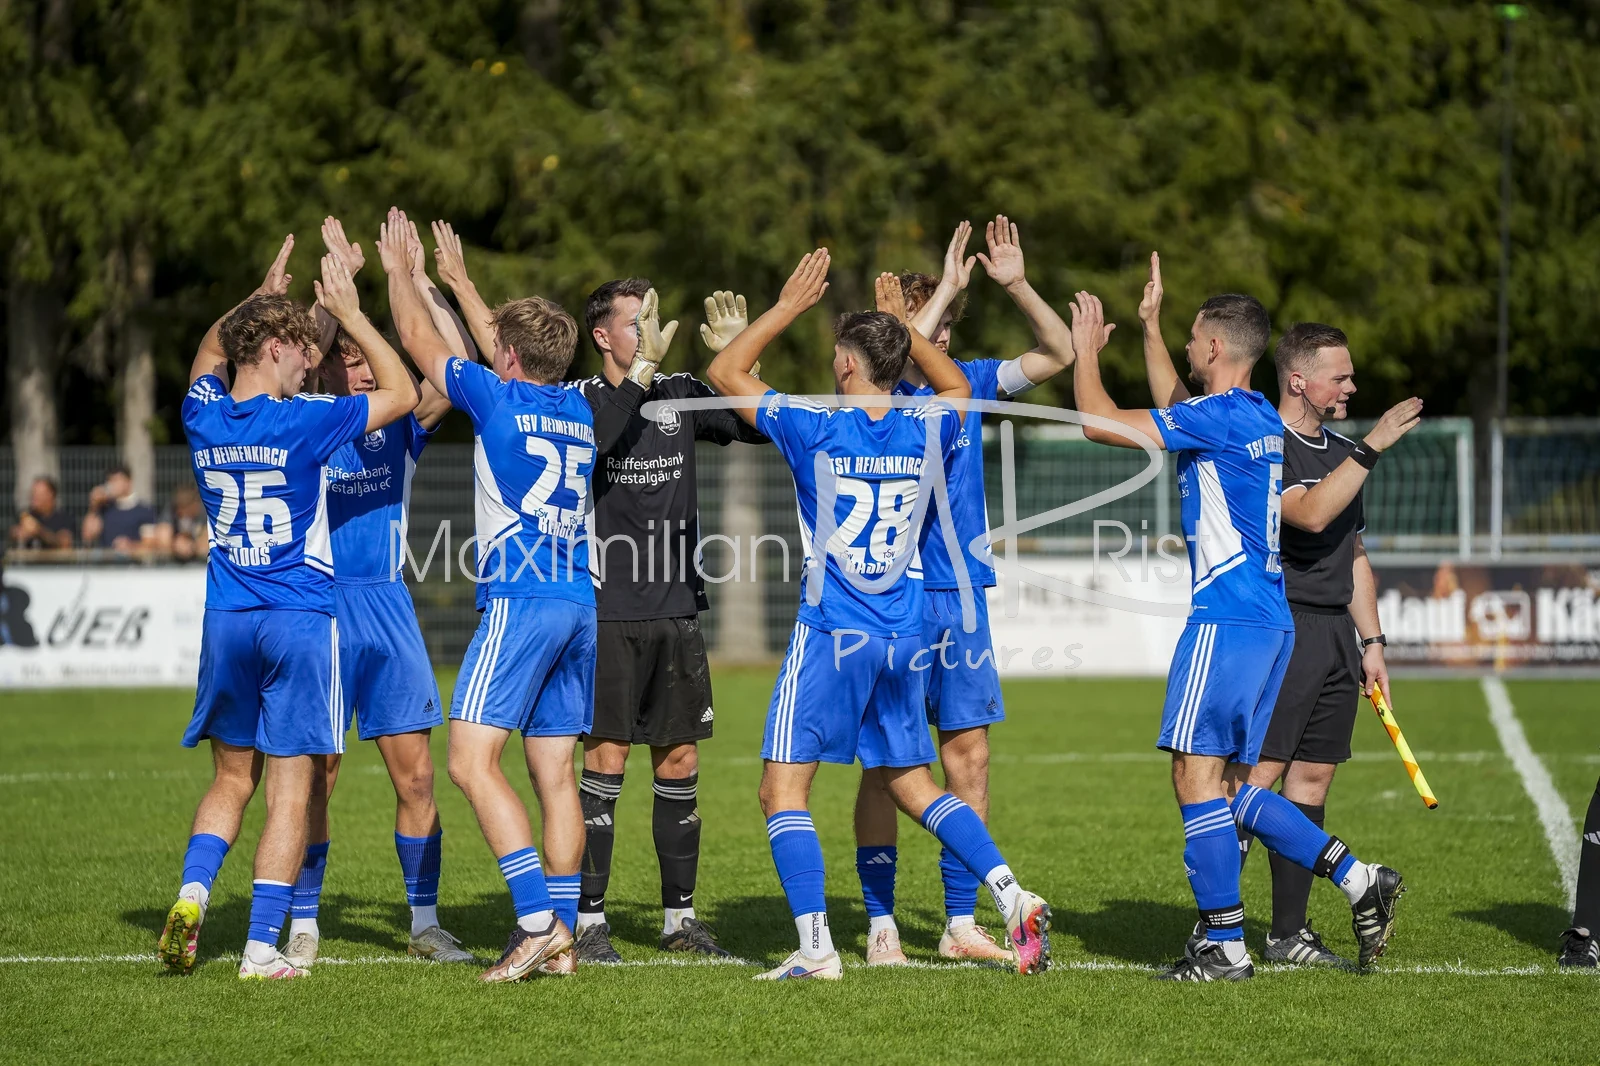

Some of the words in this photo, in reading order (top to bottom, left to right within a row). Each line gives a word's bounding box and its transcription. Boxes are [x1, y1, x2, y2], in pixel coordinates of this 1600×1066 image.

[514, 414, 537, 432] TSV
[212, 446, 288, 467] HEIMENKIRCH
[1245, 438, 1263, 460] TSV
[828, 457, 851, 475] TSV
[521, 436, 594, 525] 25
[204, 470, 293, 548] 26
[825, 477, 919, 562] 28
